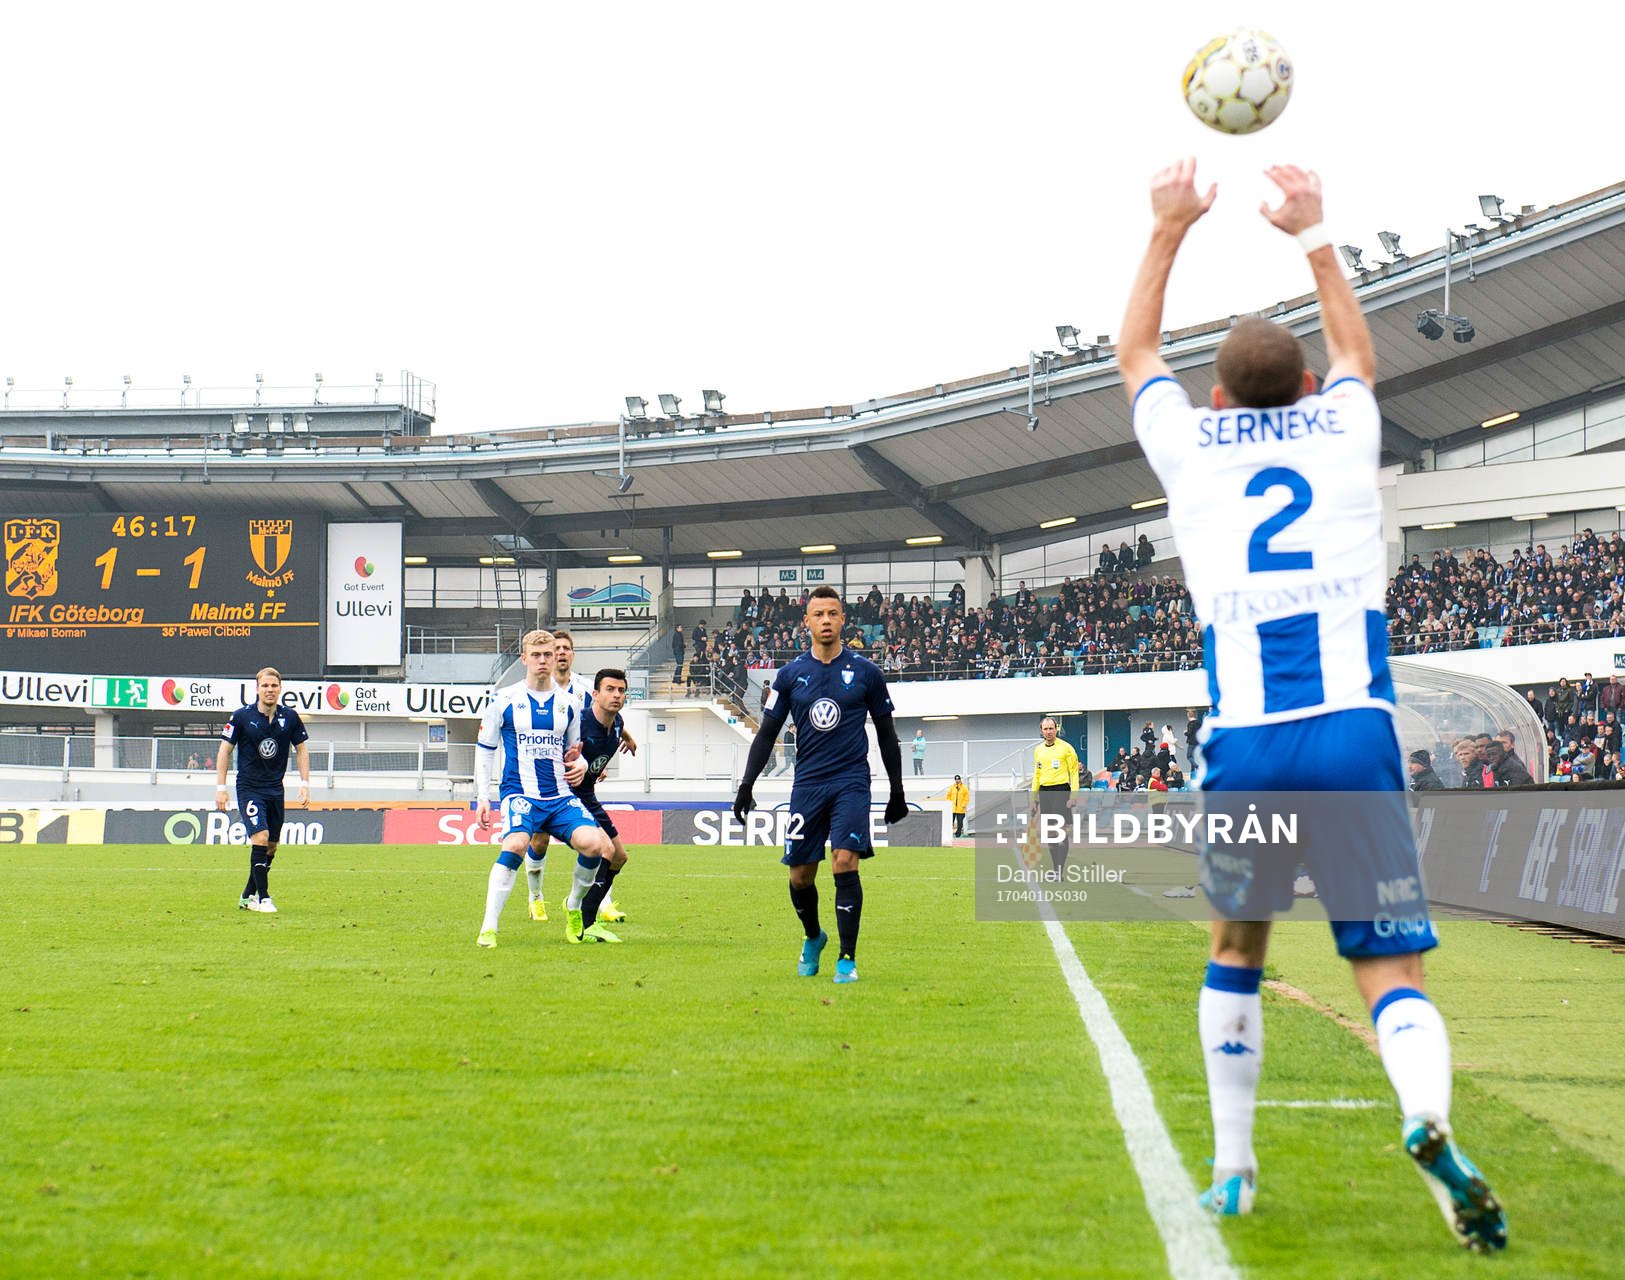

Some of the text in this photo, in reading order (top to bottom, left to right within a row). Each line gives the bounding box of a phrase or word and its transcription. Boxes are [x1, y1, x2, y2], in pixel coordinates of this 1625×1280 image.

[1198, 409, 1345, 447] SERNEKE
[112, 515, 197, 537] 46:17
[1245, 467, 1313, 573] 2
[95, 547, 118, 590] 1
[183, 546, 206, 589] 1
[780, 570, 796, 581] M5
[808, 569, 823, 580] M4
[245, 570, 282, 588] Malmö
[344, 583, 384, 591] Got Event
[9, 604, 144, 624] IFK Göteborg
[190, 602, 286, 621] Malmö FF
[336, 600, 392, 617] Ullevi
[571, 607, 650, 621] ULLEVI
[17, 628, 48, 638] Mikael
[51, 628, 87, 638] Boman
[179, 626, 212, 637] Pawel
[214, 626, 250, 637] Cibicki
[2, 676, 88, 703] Ullevi
[190, 682, 211, 694] Got
[355, 687, 377, 699] Got
[190, 696, 224, 707] Event
[240, 683, 322, 710] Uevi
[356, 702, 390, 712] Event
[246, 801, 258, 816] 6
[1373, 911, 1427, 938] Group
